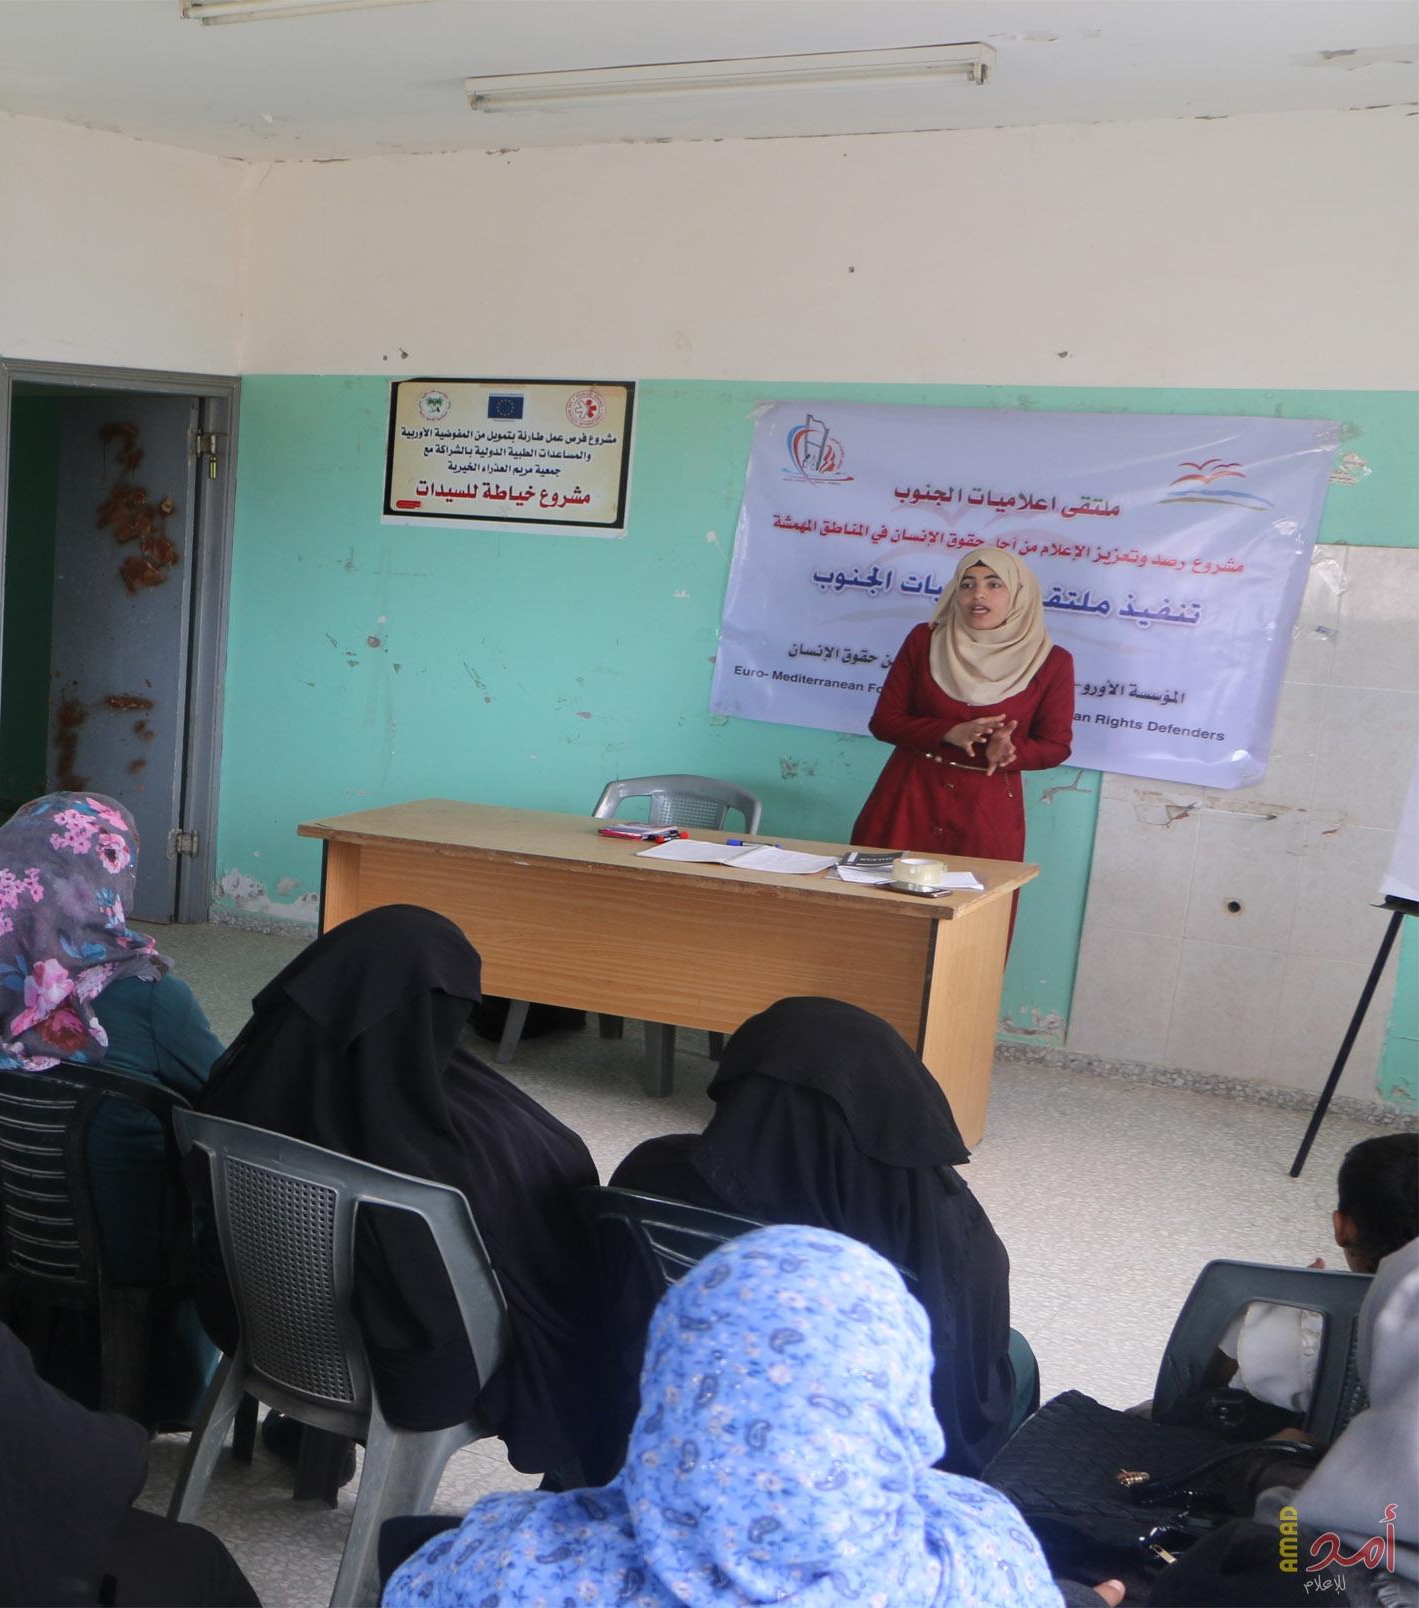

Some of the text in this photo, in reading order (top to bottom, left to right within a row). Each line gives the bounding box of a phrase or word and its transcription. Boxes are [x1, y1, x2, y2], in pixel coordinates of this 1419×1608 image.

[434, 428, 472, 441] المفوضية
[473, 430, 486, 440] من
[488, 430, 515, 444] بتمويل
[518, 430, 546, 443] طارئة
[546, 431, 564, 443] عمل
[565, 432, 587, 446] فرص
[587, 433, 617, 447] مشروع
[423, 445, 592, 463] والمساعدات الطبية الدولية بالشراكة مع
[447, 460, 561, 477] جمعية مريم العذراء الخيرية
[415, 480, 591, 509] مشروع خياطة للسيدات
[893, 484, 963, 508] الجنوب
[1060, 495, 1121, 518] ملتقى
[819, 519, 869, 537] المناطق
[871, 524, 889, 545] في
[946, 532, 985, 549] حقوق
[1018, 541, 1038, 556] من
[1092, 549, 1148, 568] وتعزيز
[1151, 553, 1186, 571] رصد
[1191, 556, 1244, 575] مشروع
[813, 566, 893, 595] الجنوب
[1118, 593, 1201, 627] تنفيذ
[841, 647, 878, 665] حقوق
[733, 664, 769, 679] Euro-
[772, 669, 864, 692] Mediterranean
[1095, 713, 1143, 730] Rights
[1146, 720, 1226, 742] Defenders
